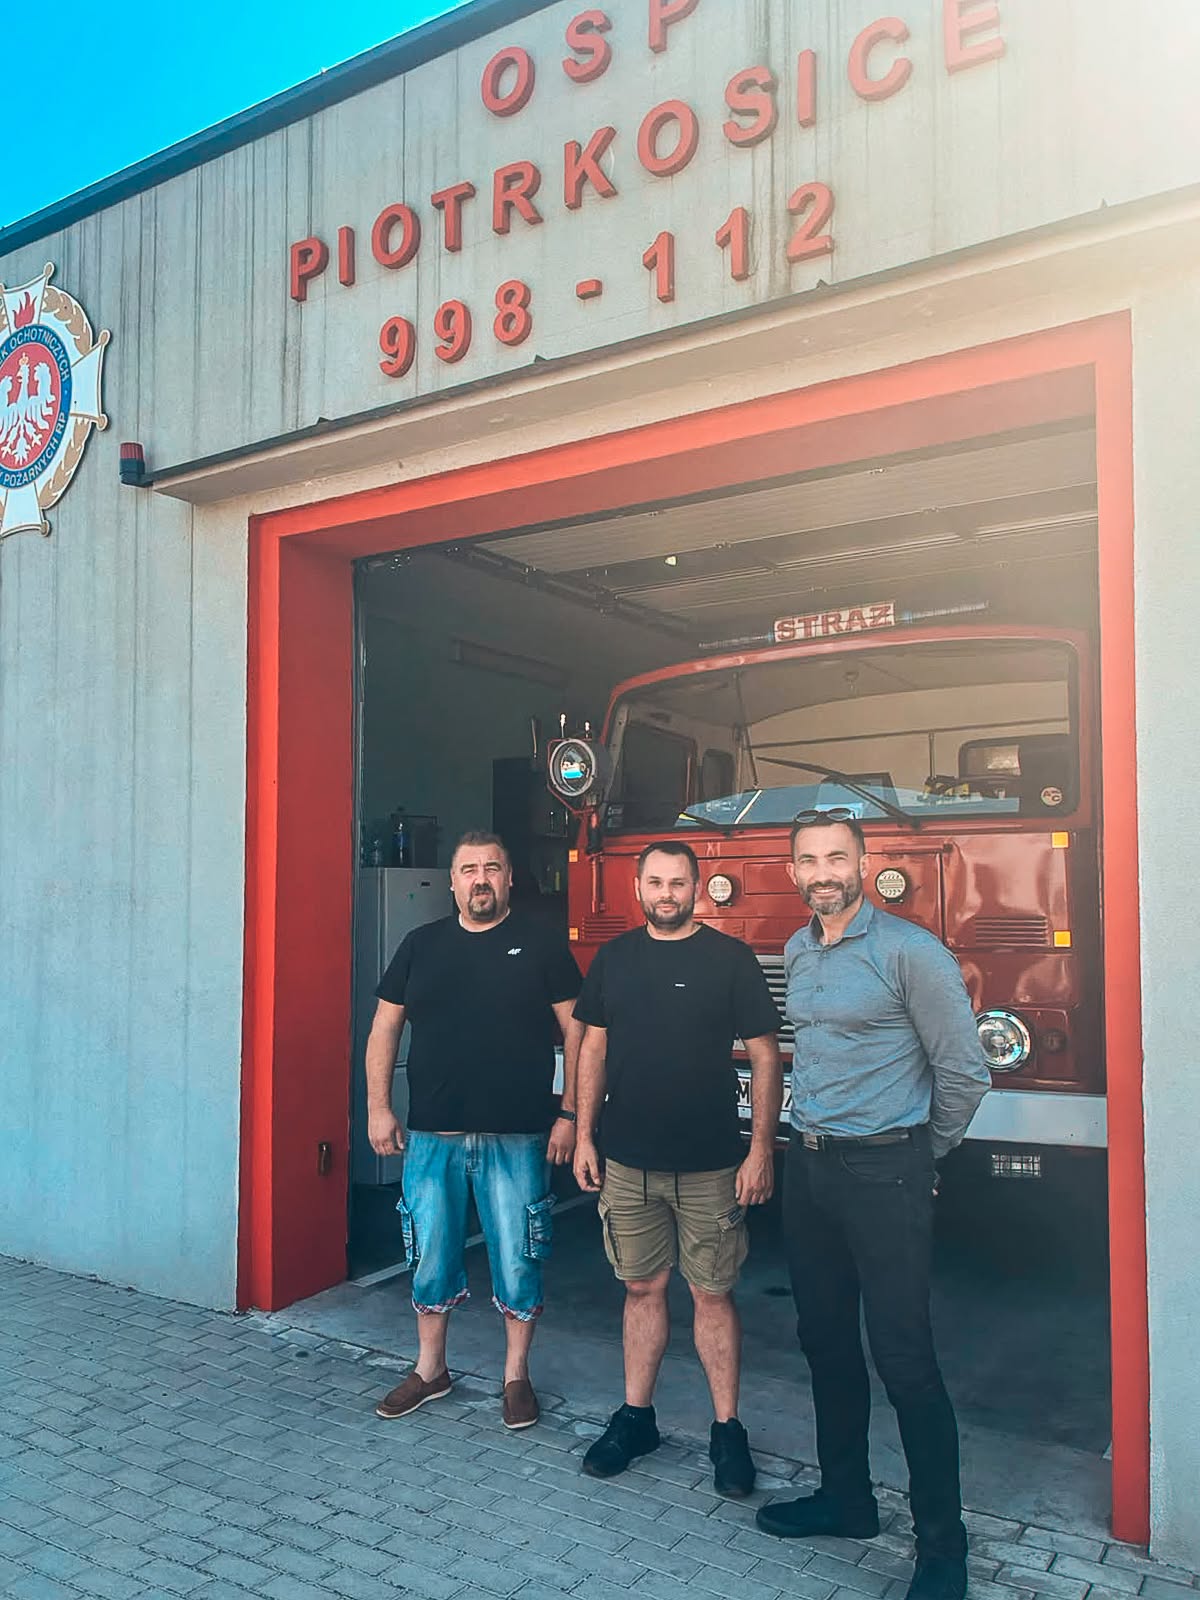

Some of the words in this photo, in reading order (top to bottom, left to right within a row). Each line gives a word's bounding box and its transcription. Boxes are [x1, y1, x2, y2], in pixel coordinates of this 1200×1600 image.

[481, 0, 700, 117] OSP
[290, 0, 1005, 301] PIOTRKOSICE
[379, 280, 532, 378] 998
[642, 182, 836, 302] 112
[10, 328, 70, 382] OCHOTNICZYCH
[55, 412, 66, 434] RP
